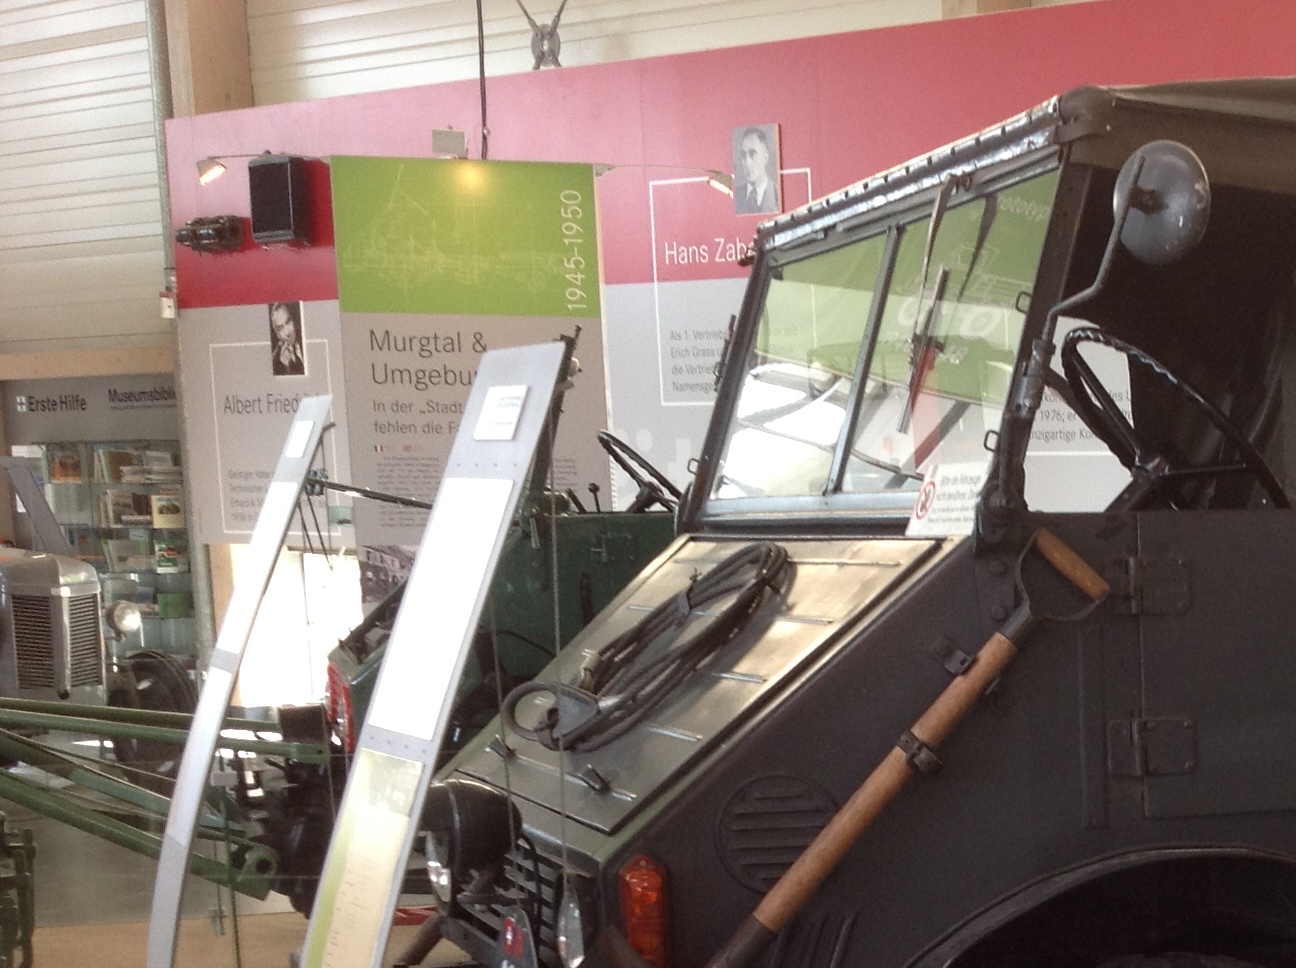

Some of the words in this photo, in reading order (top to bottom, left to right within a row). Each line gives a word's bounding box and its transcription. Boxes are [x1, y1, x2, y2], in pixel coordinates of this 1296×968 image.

[665, 241, 708, 265] Hans
[370, 329, 462, 358] Murgtal
[472, 331, 487, 352] &
[28, 396, 57, 412] Erste
[60, 394, 87, 412] Hilfe
[224, 394, 262, 414] Albert
[266, 393, 300, 414] Fried
[373, 401, 385, 412] In
[391, 400, 413, 413] der
[374, 420, 417, 434] fehlen
[422, 421, 443, 434] die
